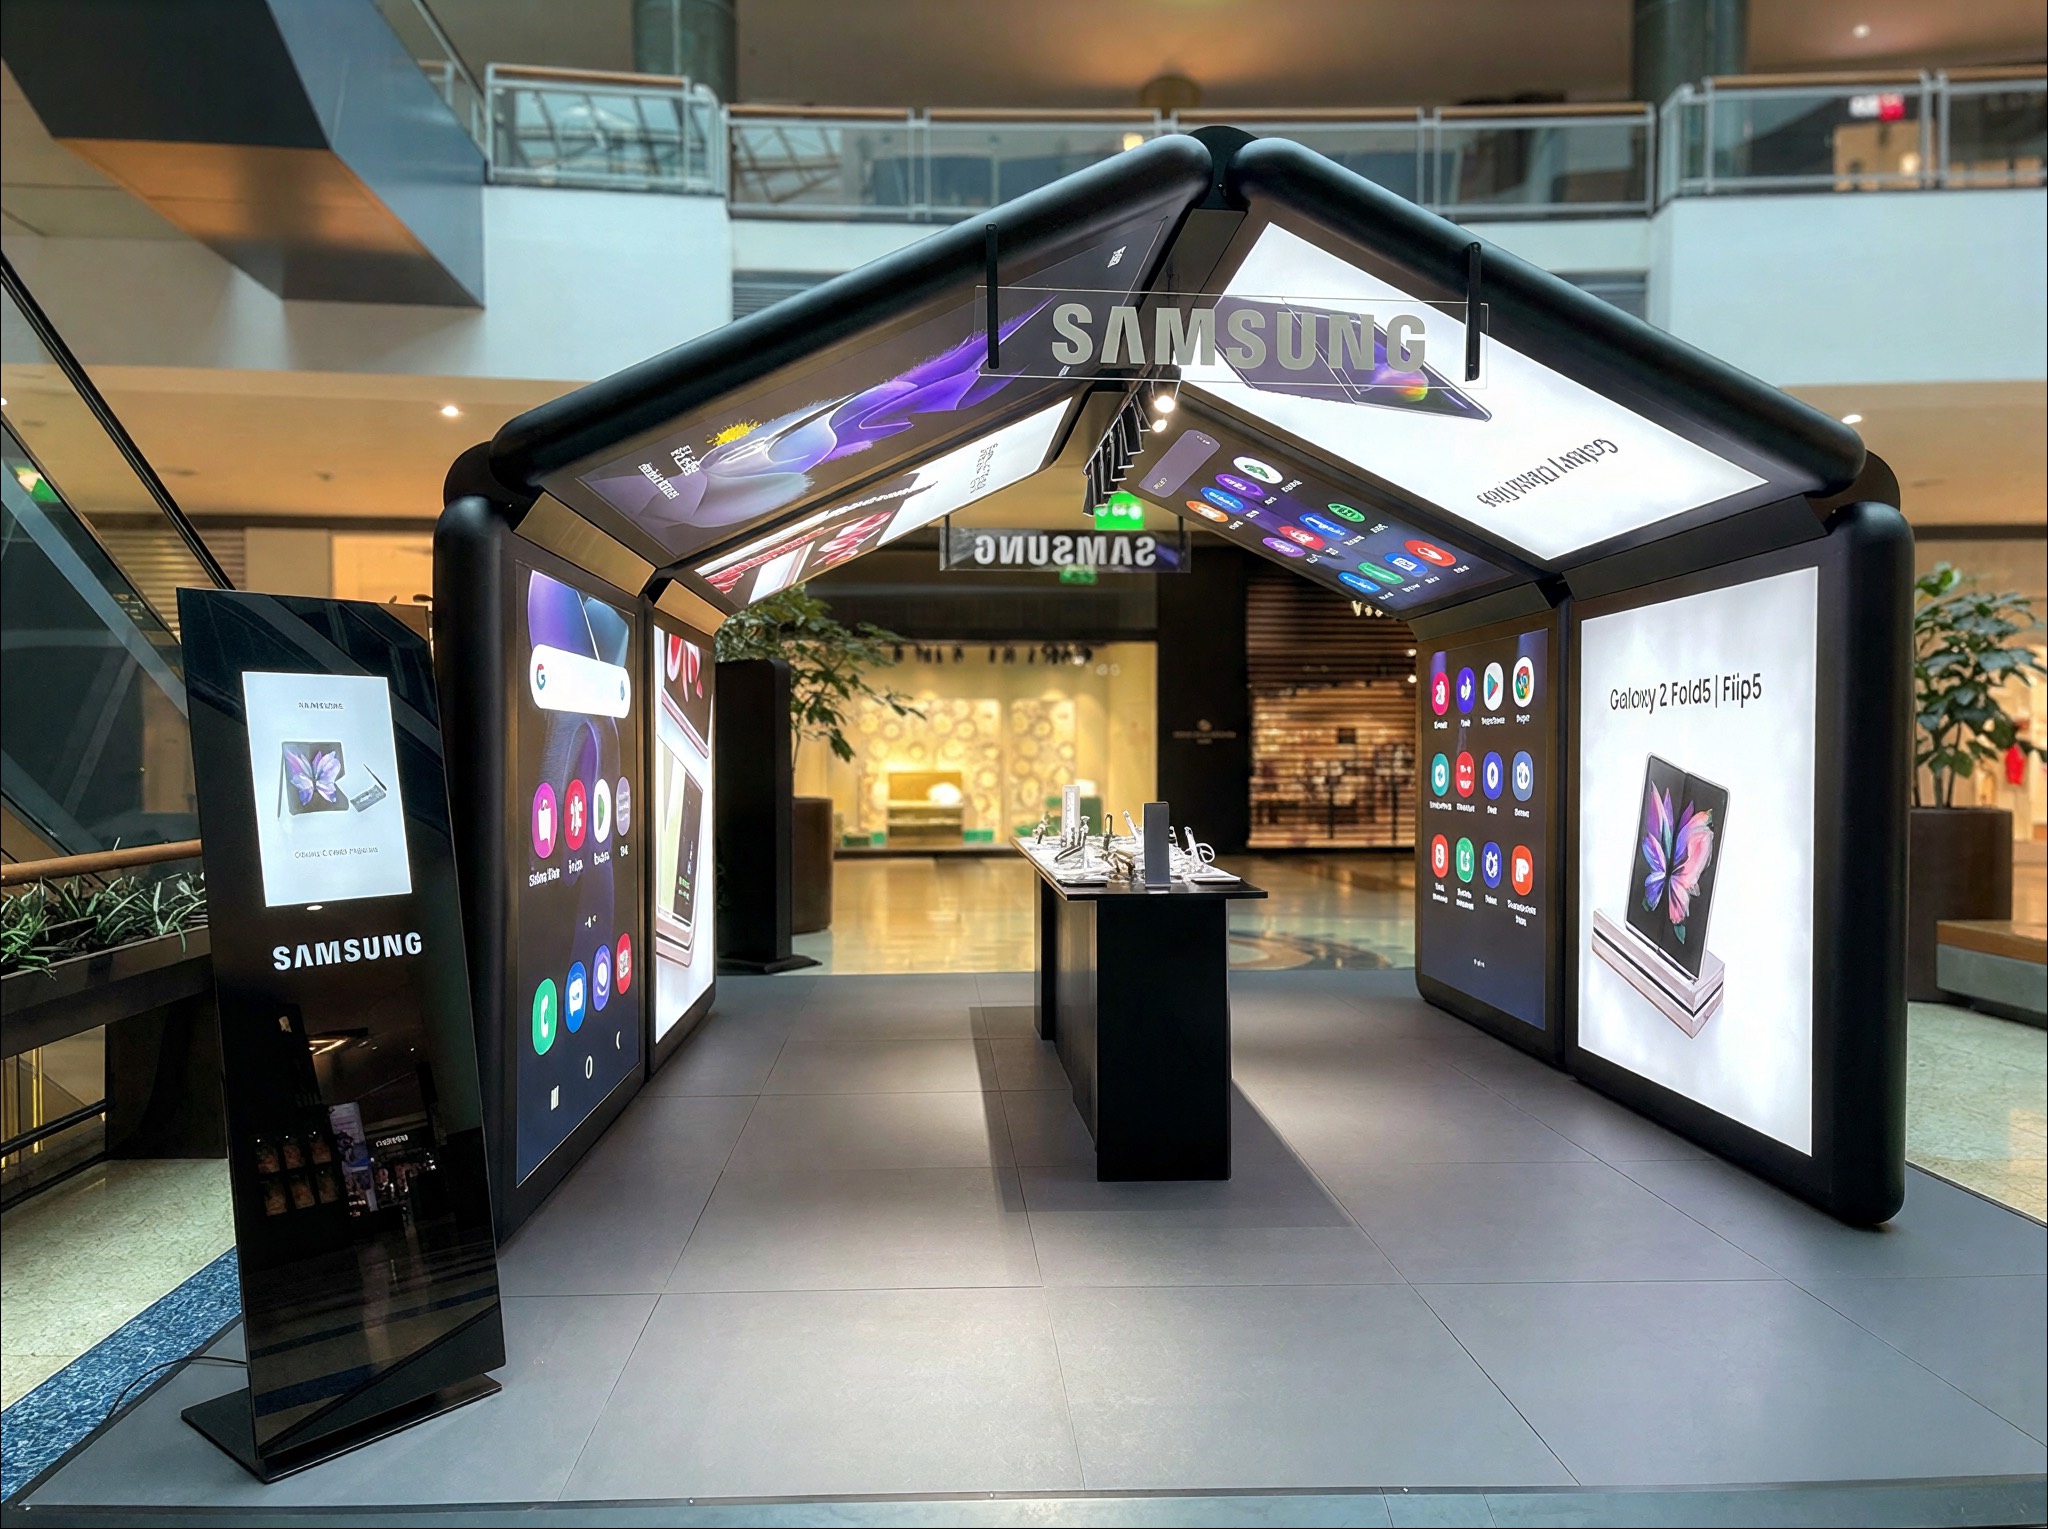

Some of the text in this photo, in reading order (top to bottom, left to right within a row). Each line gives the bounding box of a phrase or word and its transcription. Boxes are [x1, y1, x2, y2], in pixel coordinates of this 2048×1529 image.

[1051, 303, 1426, 373] SAMSUNG
[1671, 678, 1711, 706] Fold5
[272, 931, 422, 971] SAMSUNG
